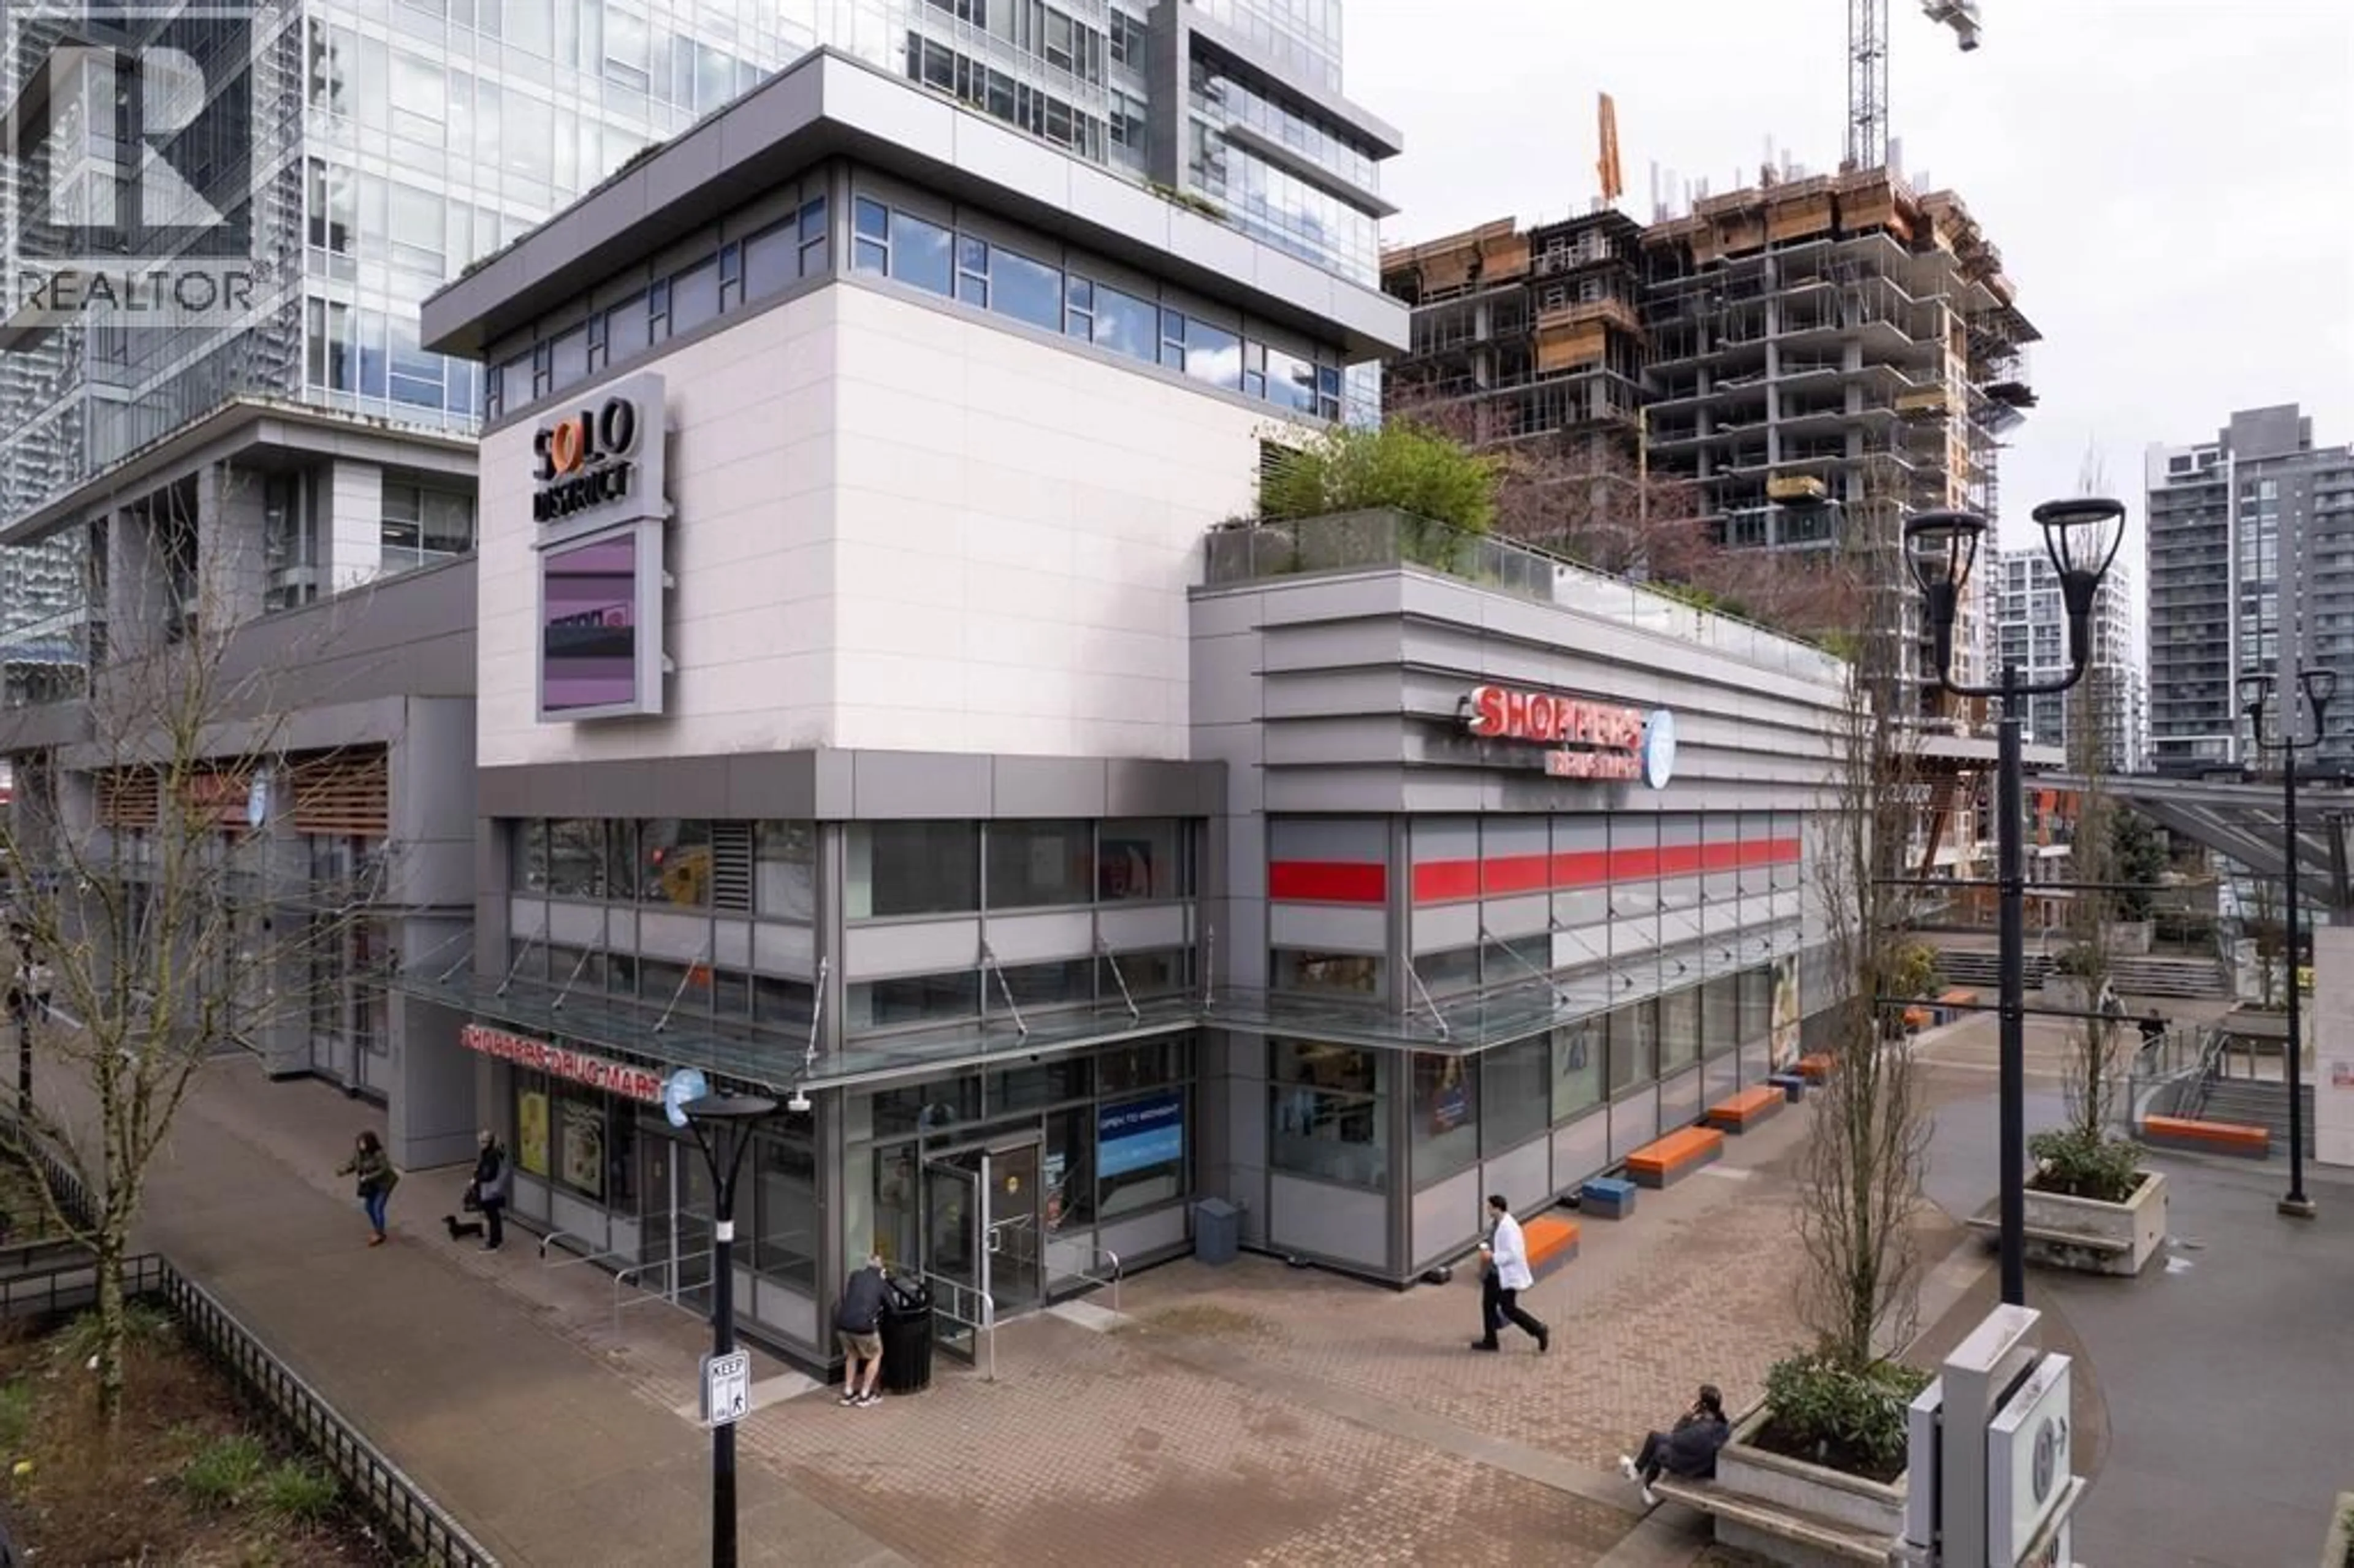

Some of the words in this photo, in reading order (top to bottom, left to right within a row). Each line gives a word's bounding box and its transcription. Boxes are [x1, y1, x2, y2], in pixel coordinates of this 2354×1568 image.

[533, 396, 636, 481] SOLO
[550, 1048, 599, 1086] DRUG
[604, 1060, 661, 1104] MART
[714, 1358, 744, 1377] KEEP
